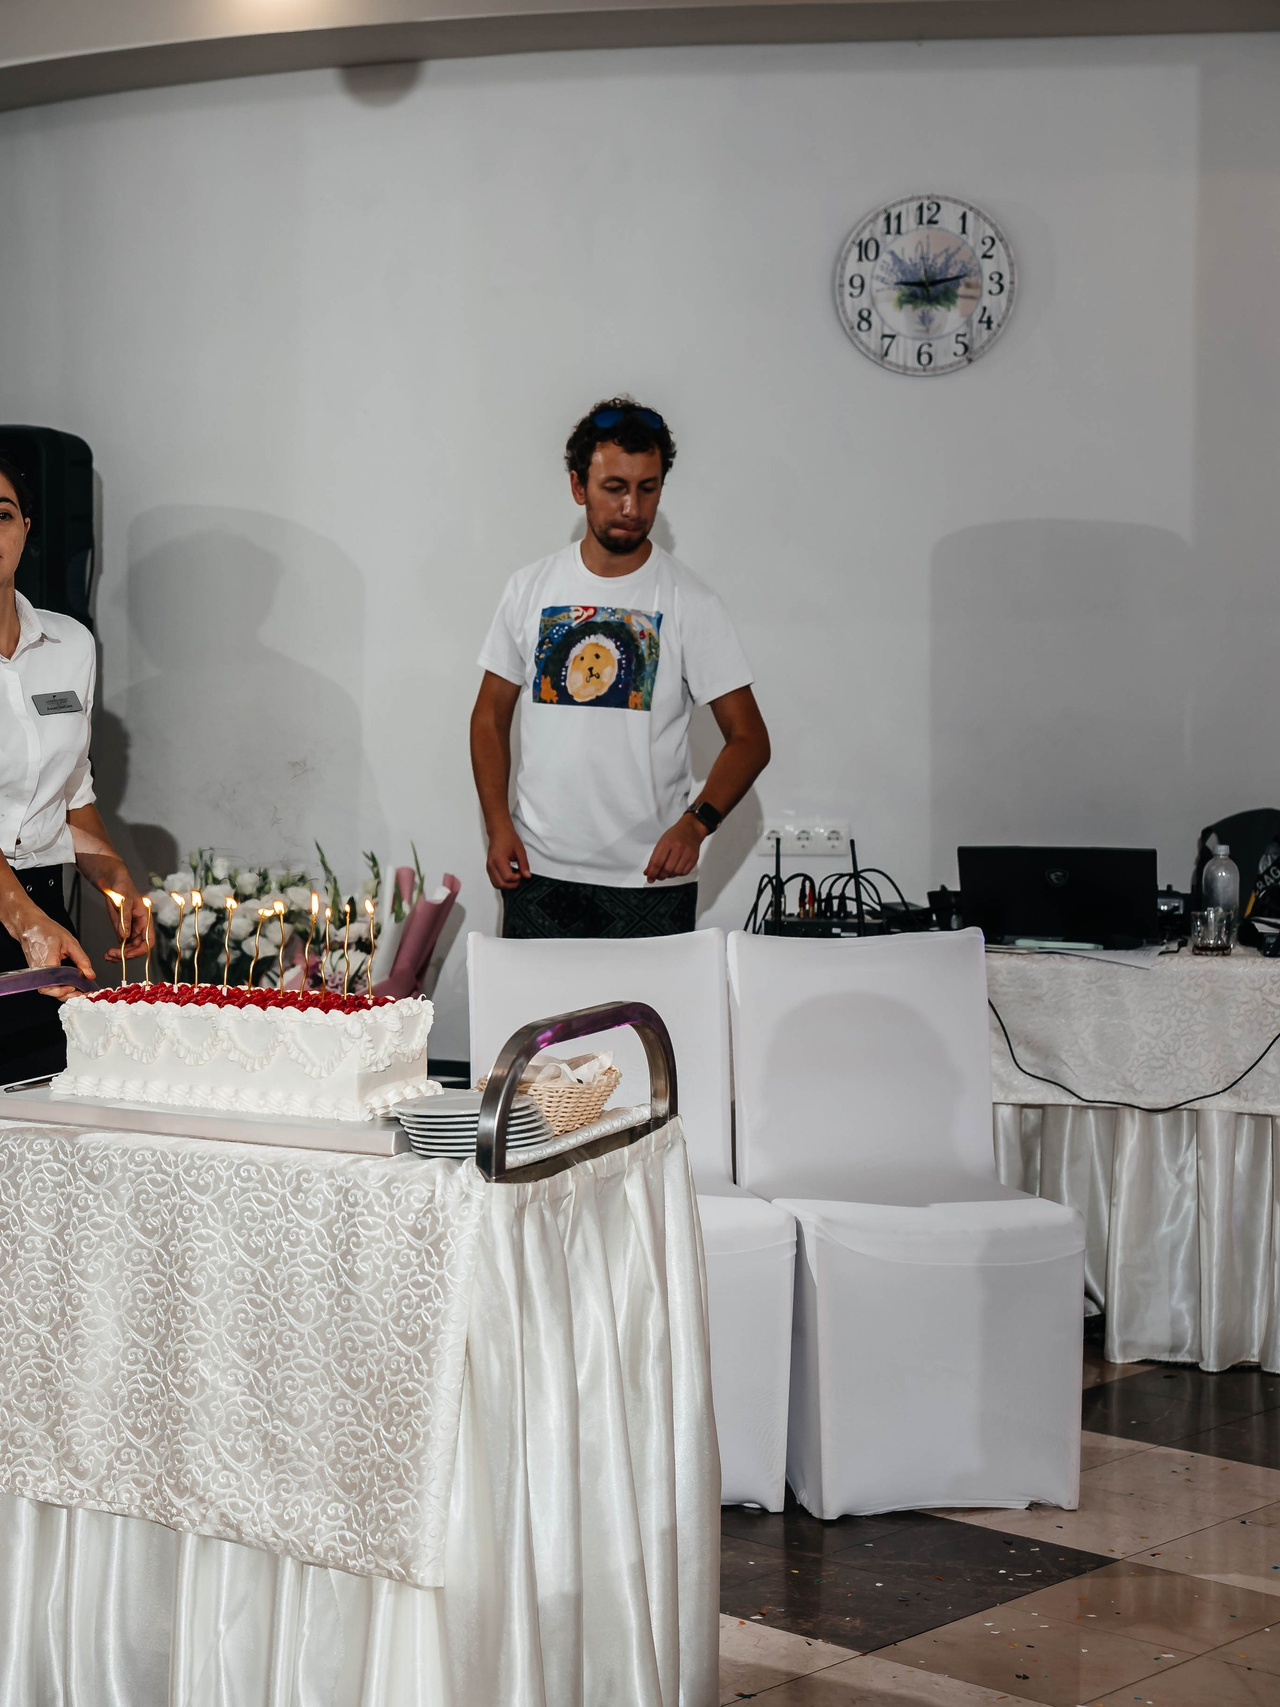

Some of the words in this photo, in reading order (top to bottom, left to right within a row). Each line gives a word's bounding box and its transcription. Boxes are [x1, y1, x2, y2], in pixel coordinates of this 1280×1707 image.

[884, 210, 902, 235] 11
[916, 201, 941, 226] 12
[959, 210, 967, 235] 1
[856, 236, 880, 262] 10
[981, 235, 996, 259] 2
[848, 273, 865, 298] 9
[988, 271, 1004, 296] 3
[857, 308, 872, 332] 8
[977, 306, 993, 330] 4
[880, 334, 896, 357] 7
[916, 342, 933, 367] 6
[953, 332, 969, 357] 5
